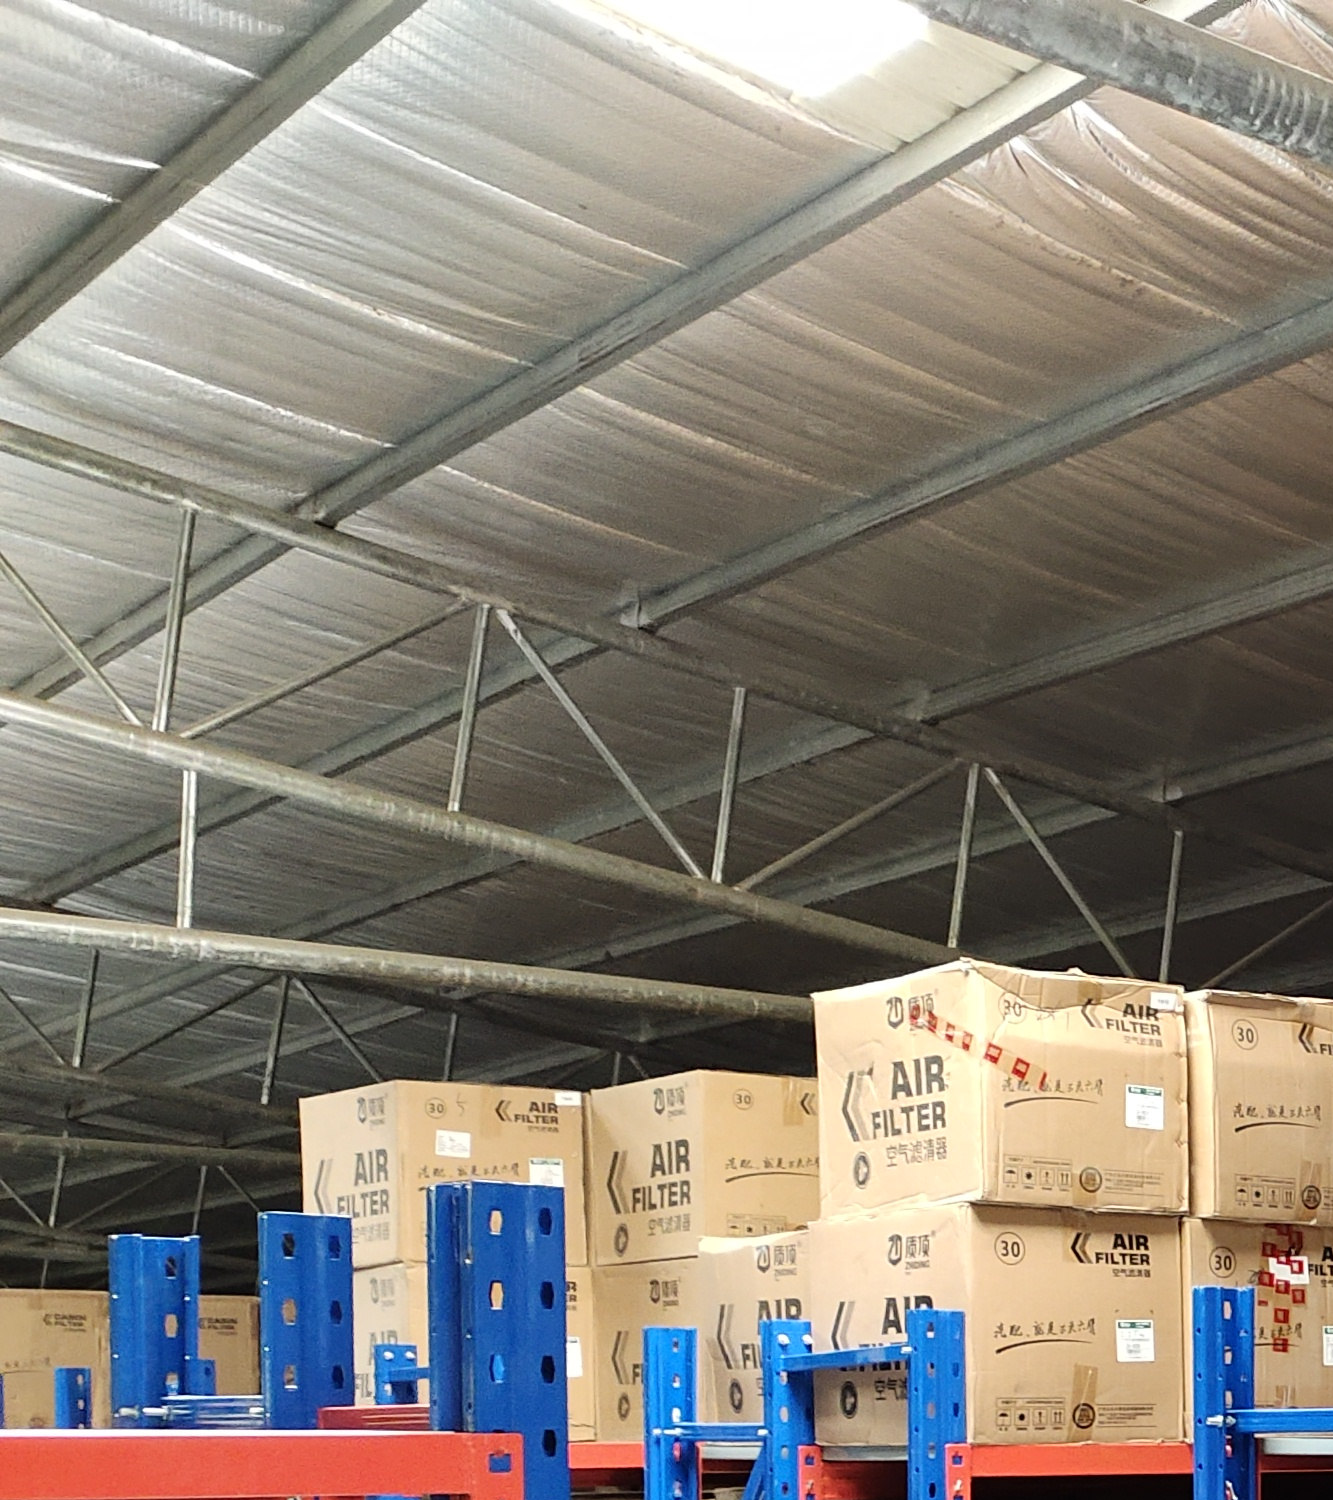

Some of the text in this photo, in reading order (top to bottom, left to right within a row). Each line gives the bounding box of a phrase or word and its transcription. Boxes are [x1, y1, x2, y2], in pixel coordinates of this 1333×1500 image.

[1122, 1002, 1158, 1021] AIR
[1106, 1018, 1162, 1036] FILTER
[1236, 1026, 1254, 1044] 30
[891, 1055, 945, 1100] AIR
[428, 1103, 444, 1113] 30
[529, 1102, 558, 1114] AIR
[736, 1094, 751, 1104] 30
[514, 1115, 559, 1124] FILTER
[872, 1101, 946, 1139] FILTER
[650, 1139, 689, 1178] AIR
[886, 1137, 947, 1168] 空气滤清器
[354, 1149, 388, 1186] AIR
[337, 1190, 389, 1217] FILTER
[632, 1180, 691, 1213] FILTER
[905, 1234, 930, 1258] 质顶
[1001, 1241, 1020, 1257] 30
[1112, 1234, 1149, 1251] AIR
[1095, 1252, 1150, 1266] FILTER
[1214, 1253, 1232, 1271] 30
